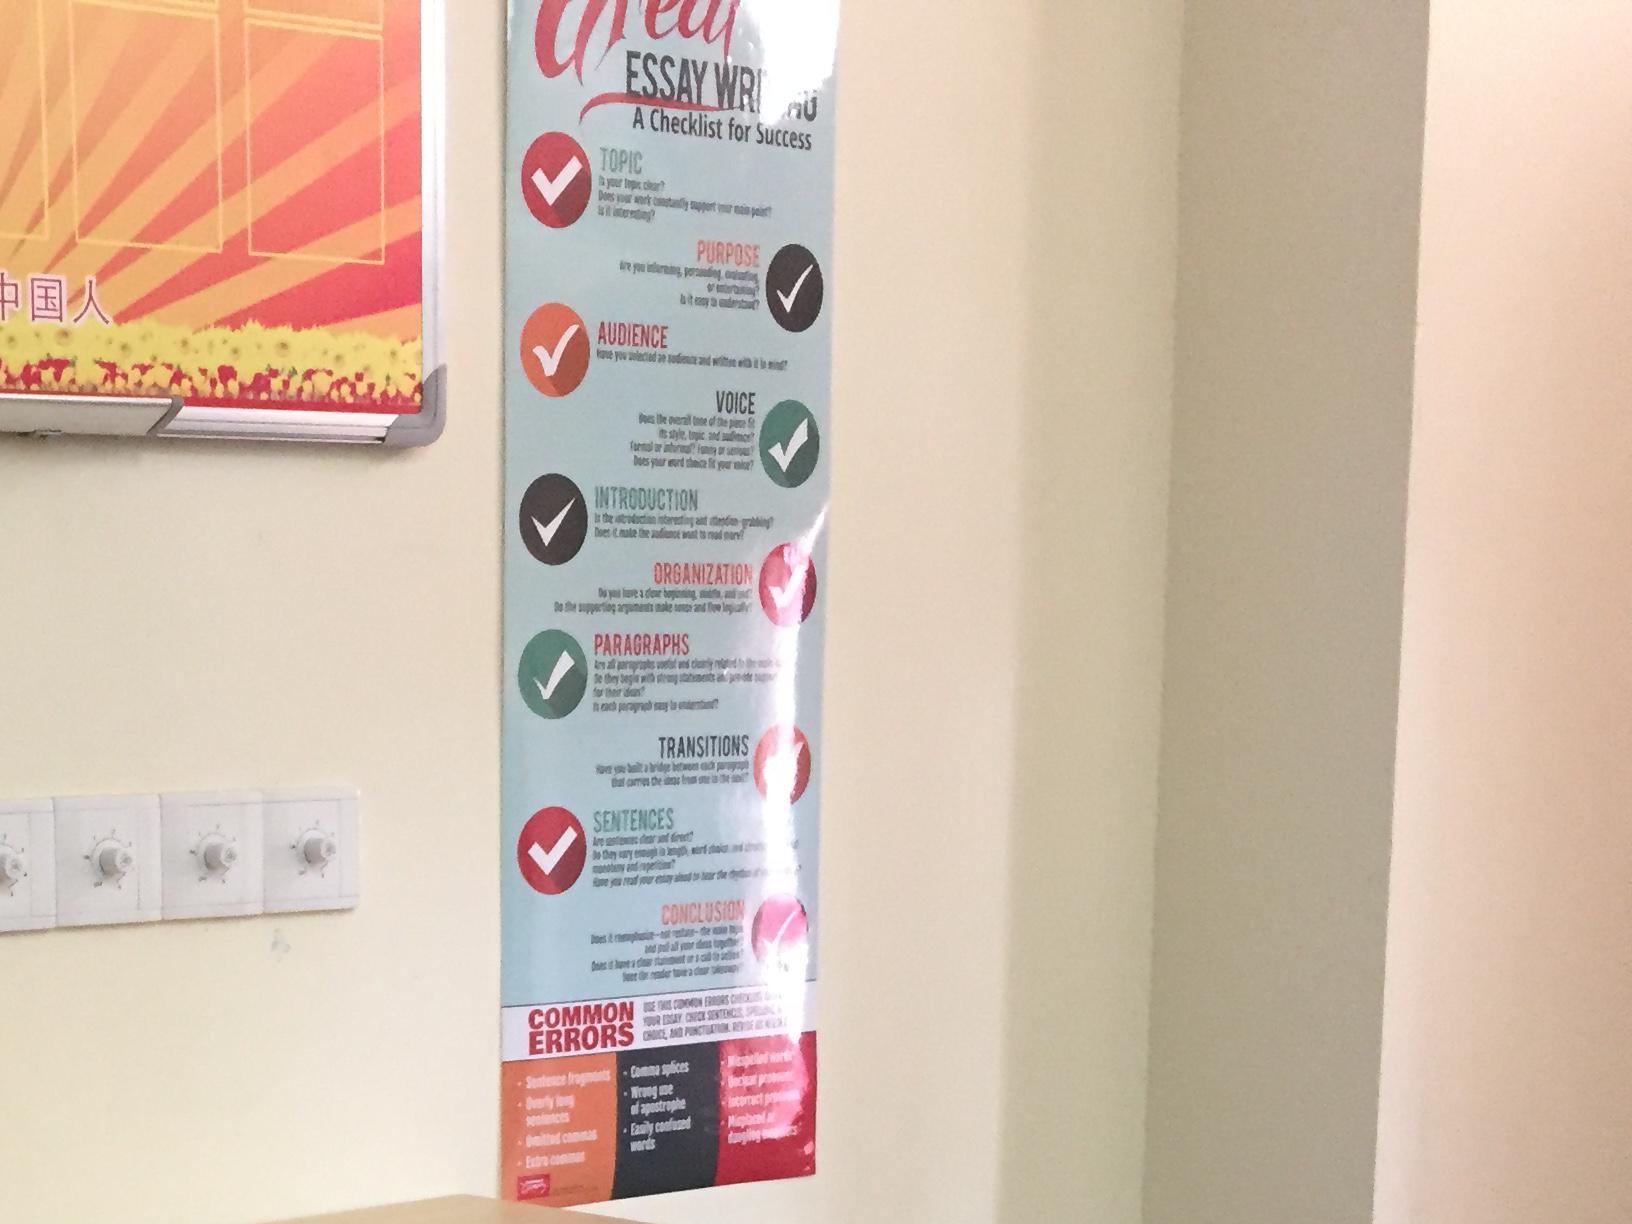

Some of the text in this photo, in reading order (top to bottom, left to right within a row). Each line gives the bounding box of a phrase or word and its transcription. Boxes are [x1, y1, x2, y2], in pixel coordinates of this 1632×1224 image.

[626, 50, 818, 122] ESSAY WRIG
[632, 107, 812, 150] A Checklist for Success
[600, 147, 643, 174] TOPIC
[697, 240, 760, 268] PURPOSE
[597, 321, 668, 348] AUDIENCE
[716, 390, 756, 414] VOICE
[594, 486, 699, 511] INTRODUCTION
[654, 562, 753, 585] ORGANIZATION
[594, 634, 690, 656] PARAGRAPHS
[658, 735, 750, 759] TRANSITIONS
[593, 808, 674, 833] SENTENCES
[662, 900, 744, 925] CONCLUSION
[528, 1001, 635, 1030] COMMON
[529, 1022, 634, 1055] ERRORS
[631, 1060, 690, 1079] Comma splices
[631, 1084, 674, 1100] Wrong use
[631, 1098, 686, 1116] of apostrophe
[631, 1120, 654, 1136] Easily
[630, 1138, 656, 1152] words
